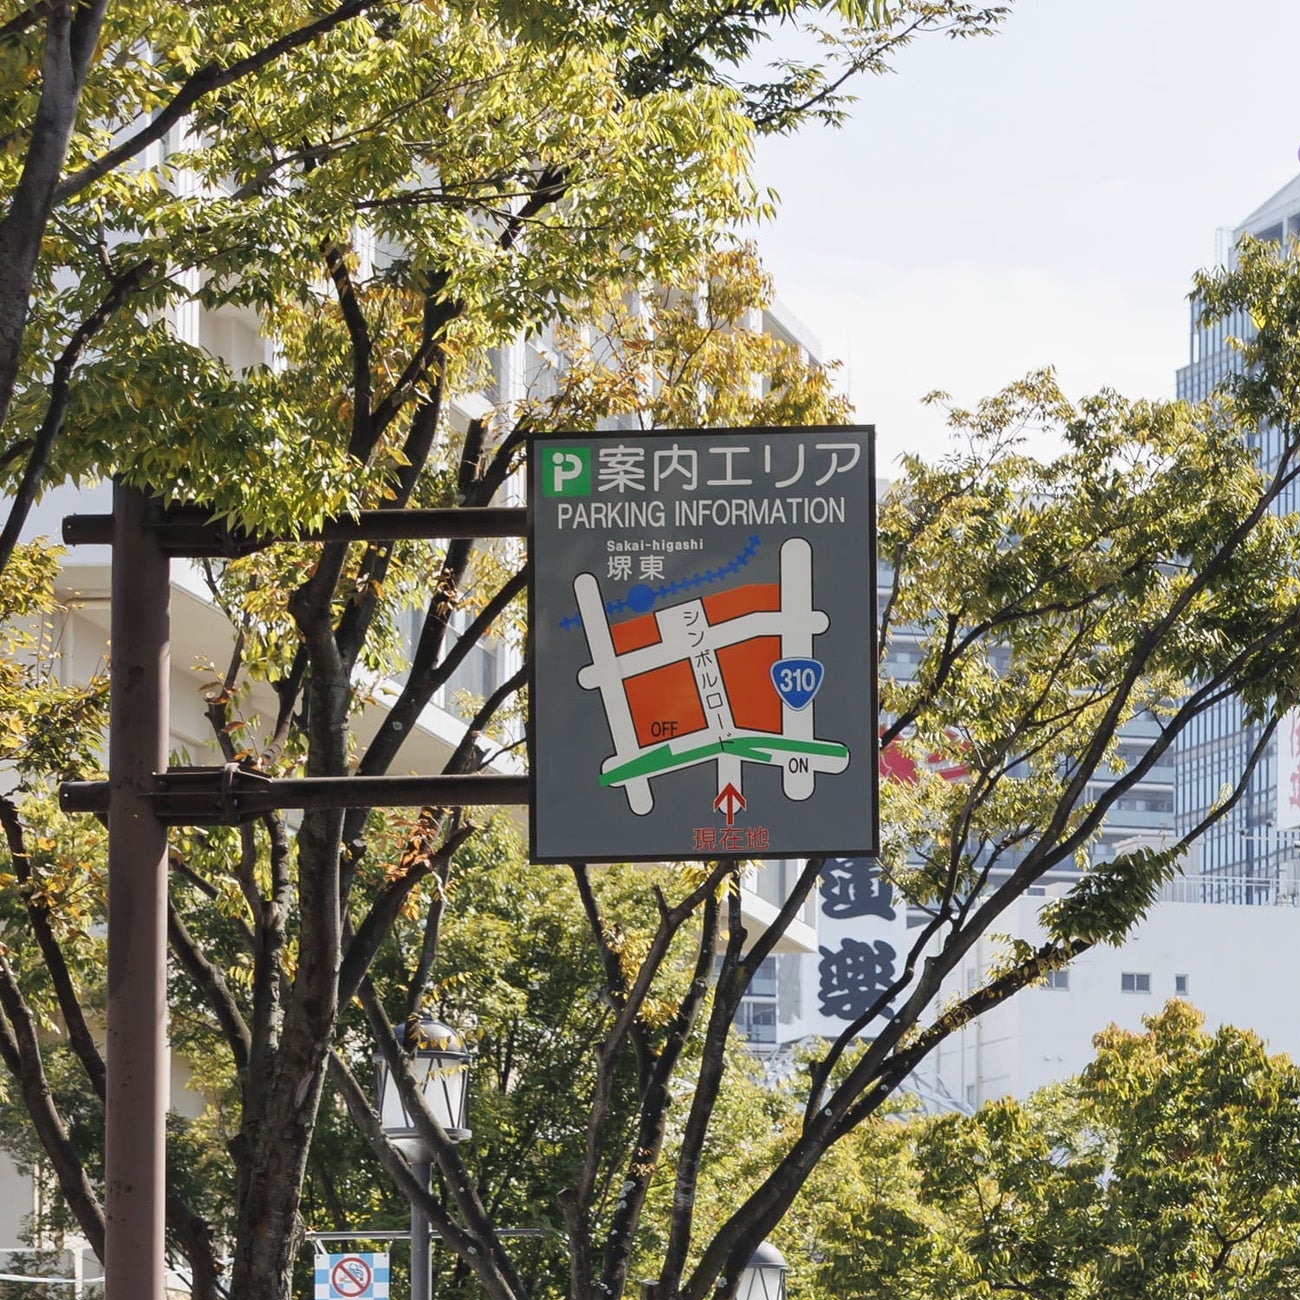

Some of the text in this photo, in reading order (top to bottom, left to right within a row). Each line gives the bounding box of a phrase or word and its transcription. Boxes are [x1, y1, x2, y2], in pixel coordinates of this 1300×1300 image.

[597, 443, 860, 492] 案内エリア
[557, 497, 846, 530] PARKING INFORMATION
[606, 537, 704, 553] Sakai-higashi
[606, 554, 665, 581] 堺東
[683, 609, 735, 752] シンボルロード
[779, 667, 816, 692] 310
[650, 721, 679, 737] OFF
[788, 757, 809, 774] ON
[693, 826, 771, 851] 現在地
